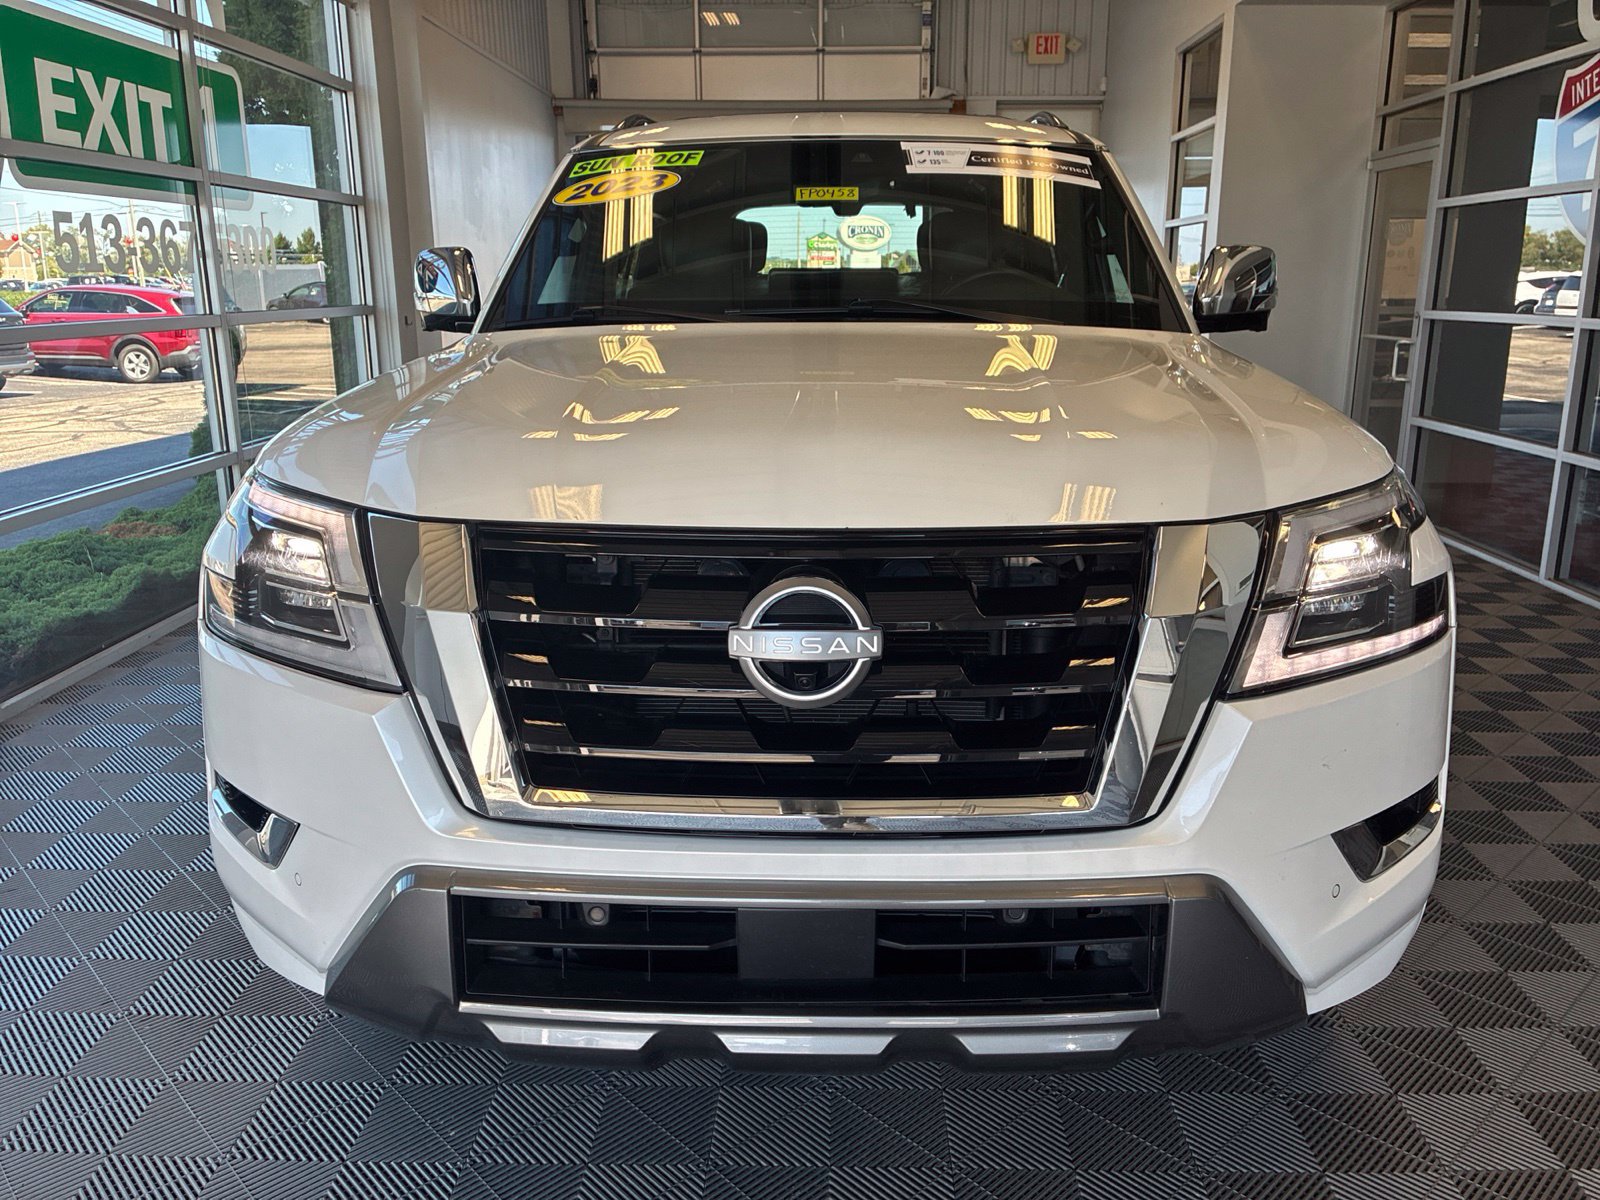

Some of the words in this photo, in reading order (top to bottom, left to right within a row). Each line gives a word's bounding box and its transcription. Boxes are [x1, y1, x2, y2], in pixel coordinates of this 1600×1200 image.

[1036, 35, 1060, 55] EXIT
[34, 57, 172, 162] EXIT
[573, 155, 623, 175] SUN
[630, 152, 700, 168] ROOF
[971, 155, 1023, 165] Certified
[1026, 159, 1089, 175] Pre-Owned
[564, 174, 669, 203] 2023
[848, 225, 884, 238] CRONIN
[733, 635, 878, 655] NISSAN
